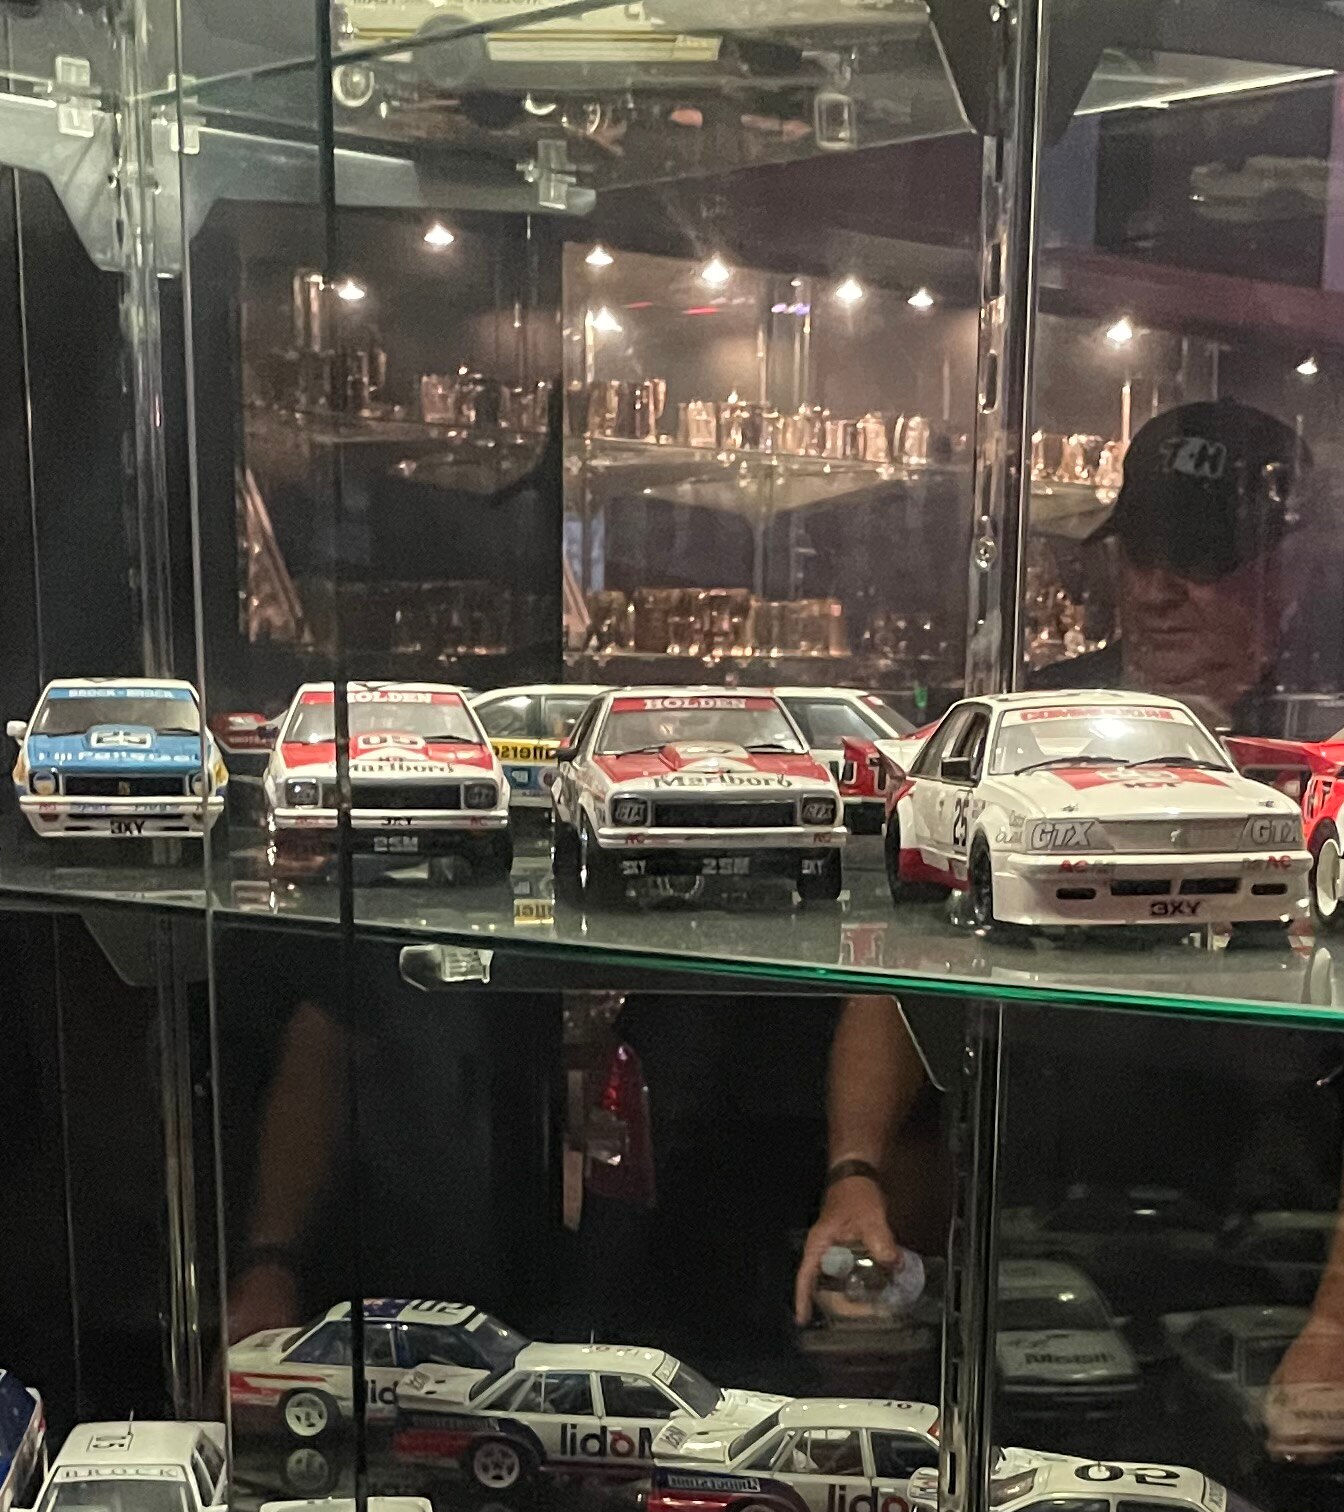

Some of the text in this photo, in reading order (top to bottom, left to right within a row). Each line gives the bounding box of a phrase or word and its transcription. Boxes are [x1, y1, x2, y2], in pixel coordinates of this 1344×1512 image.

[644, 698, 747, 710] HOLDEN
[653, 773, 794, 789] Marlboro
[1030, 821, 1095, 850] GTX
